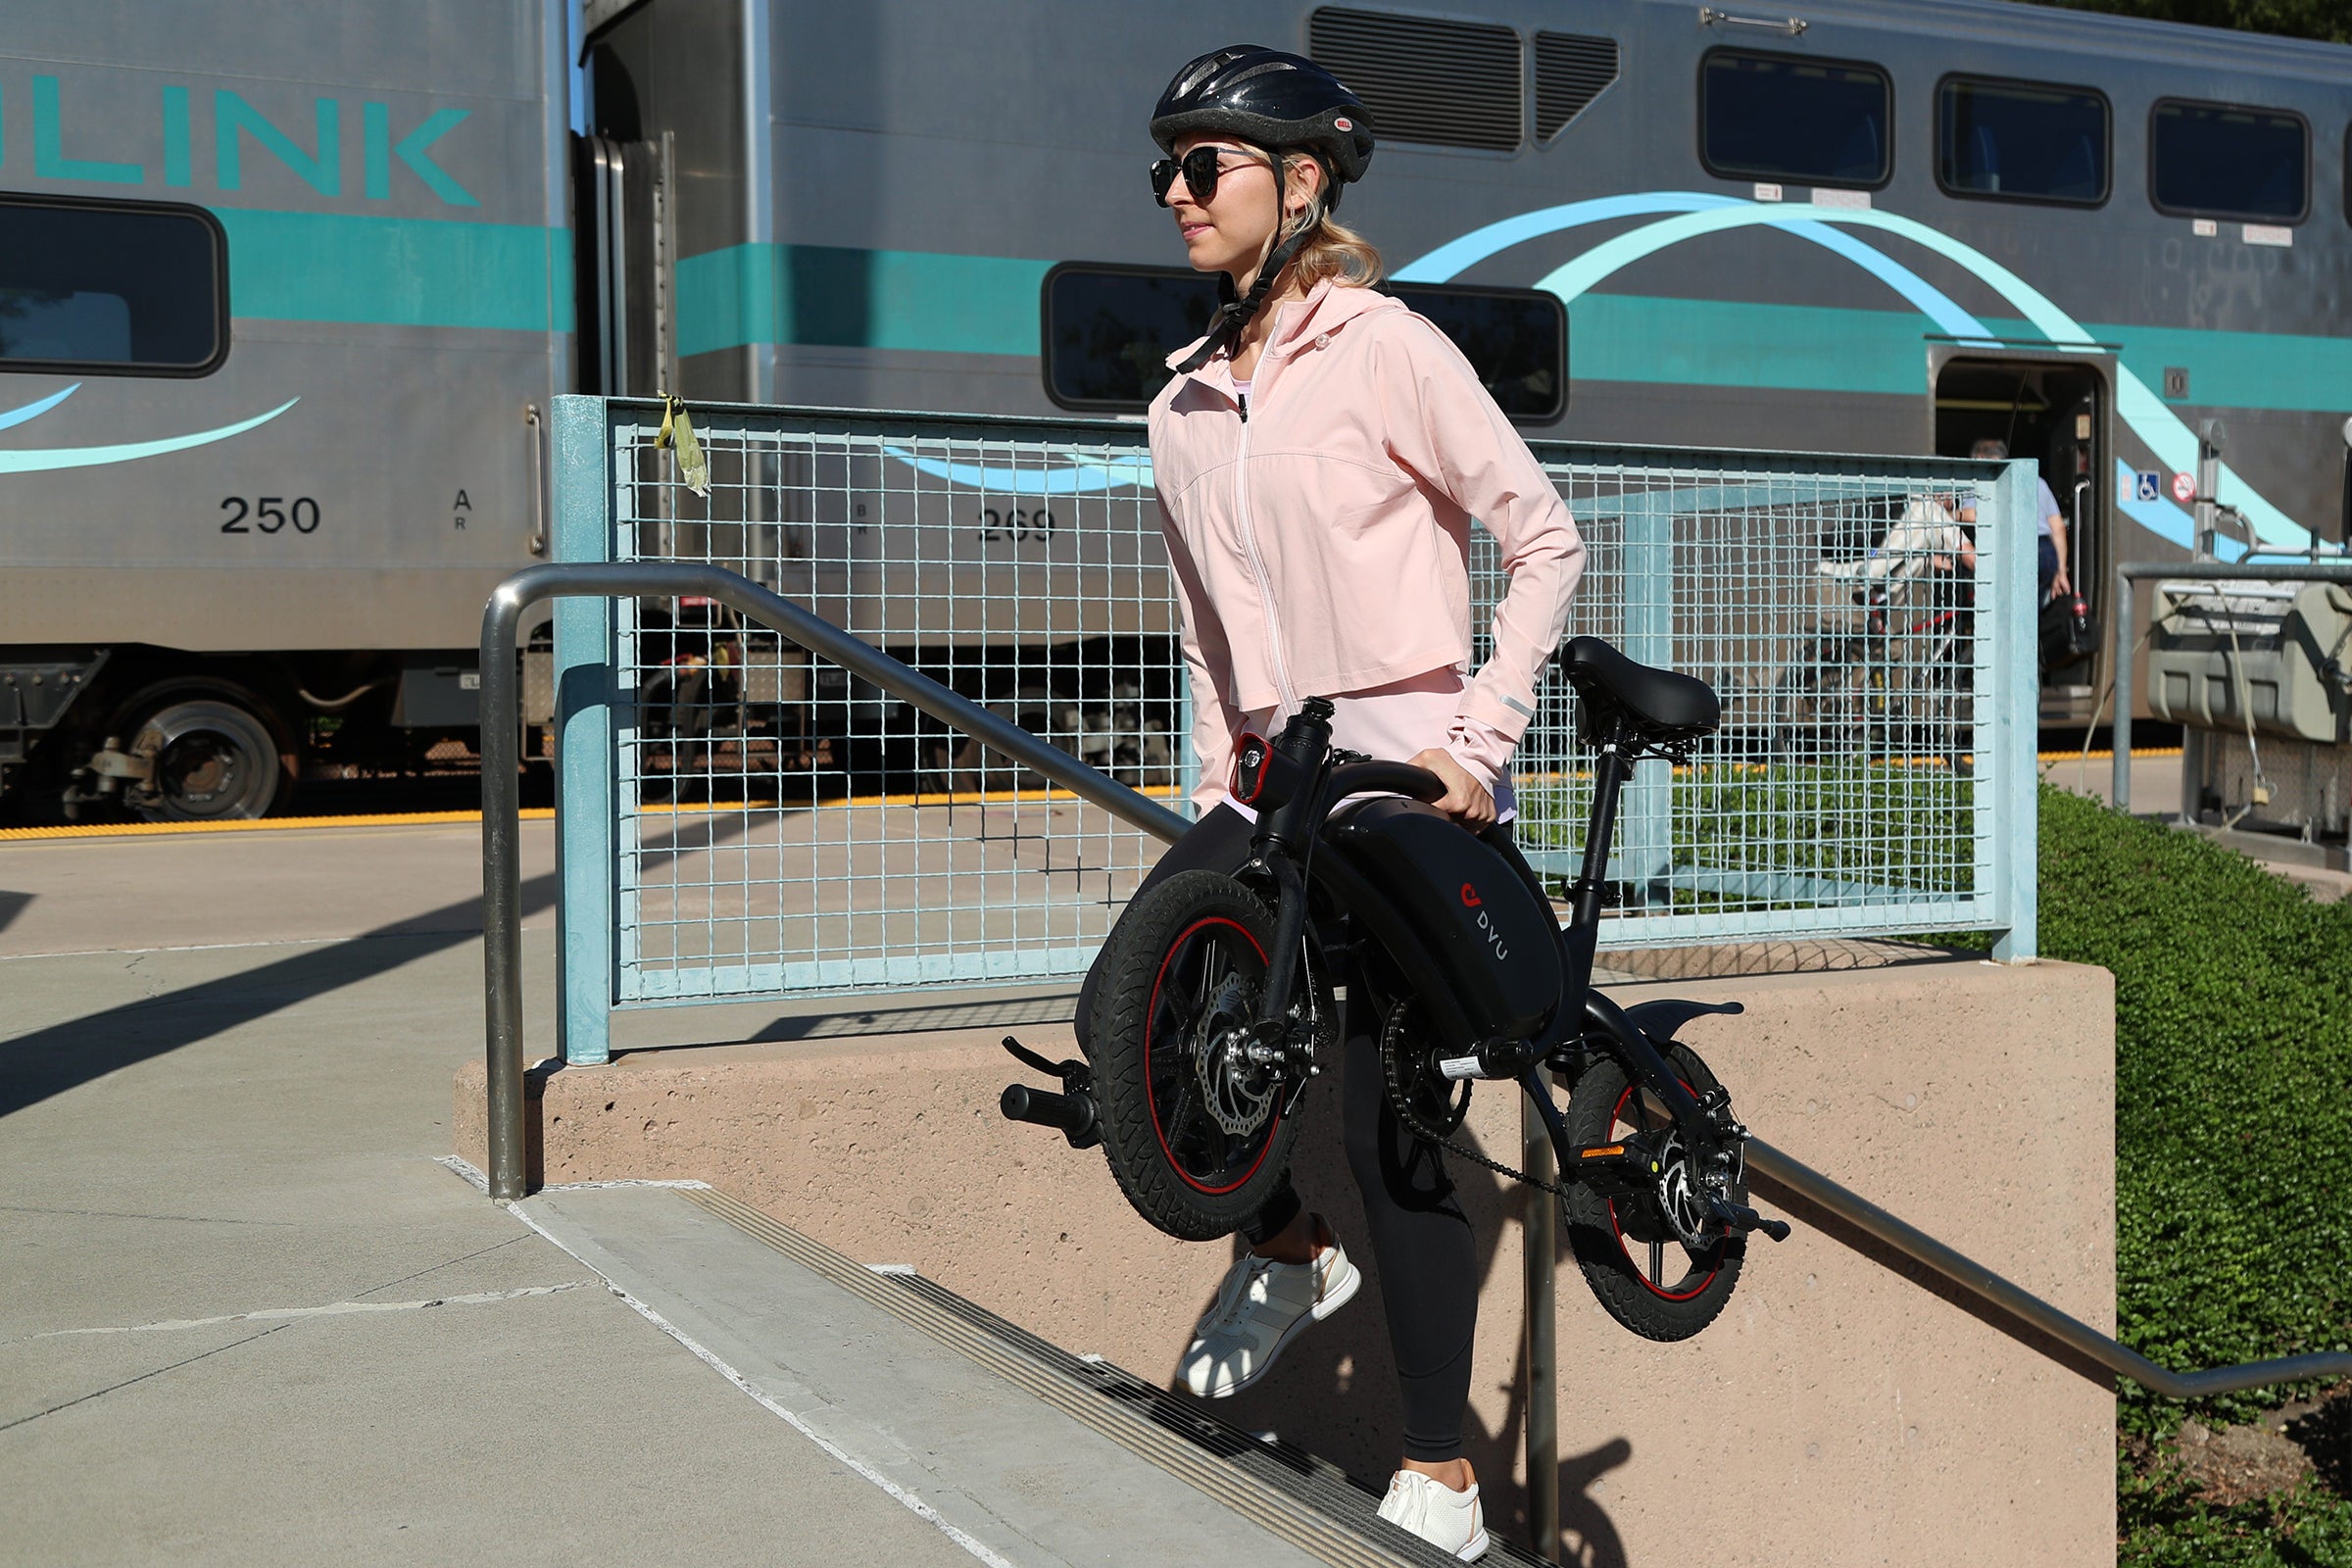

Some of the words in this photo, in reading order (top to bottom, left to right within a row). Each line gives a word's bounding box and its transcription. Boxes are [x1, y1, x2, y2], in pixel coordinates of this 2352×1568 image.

[1337, 120, 1351, 128] BELL
[0, 74, 481, 207] LINK
[453, 489, 472, 512] A
[857, 504, 867, 517] B
[220, 496, 320, 534] 250
[455, 516, 466, 530] R
[978, 509, 1055, 542] 269
[1477, 909, 1508, 960] DYU
